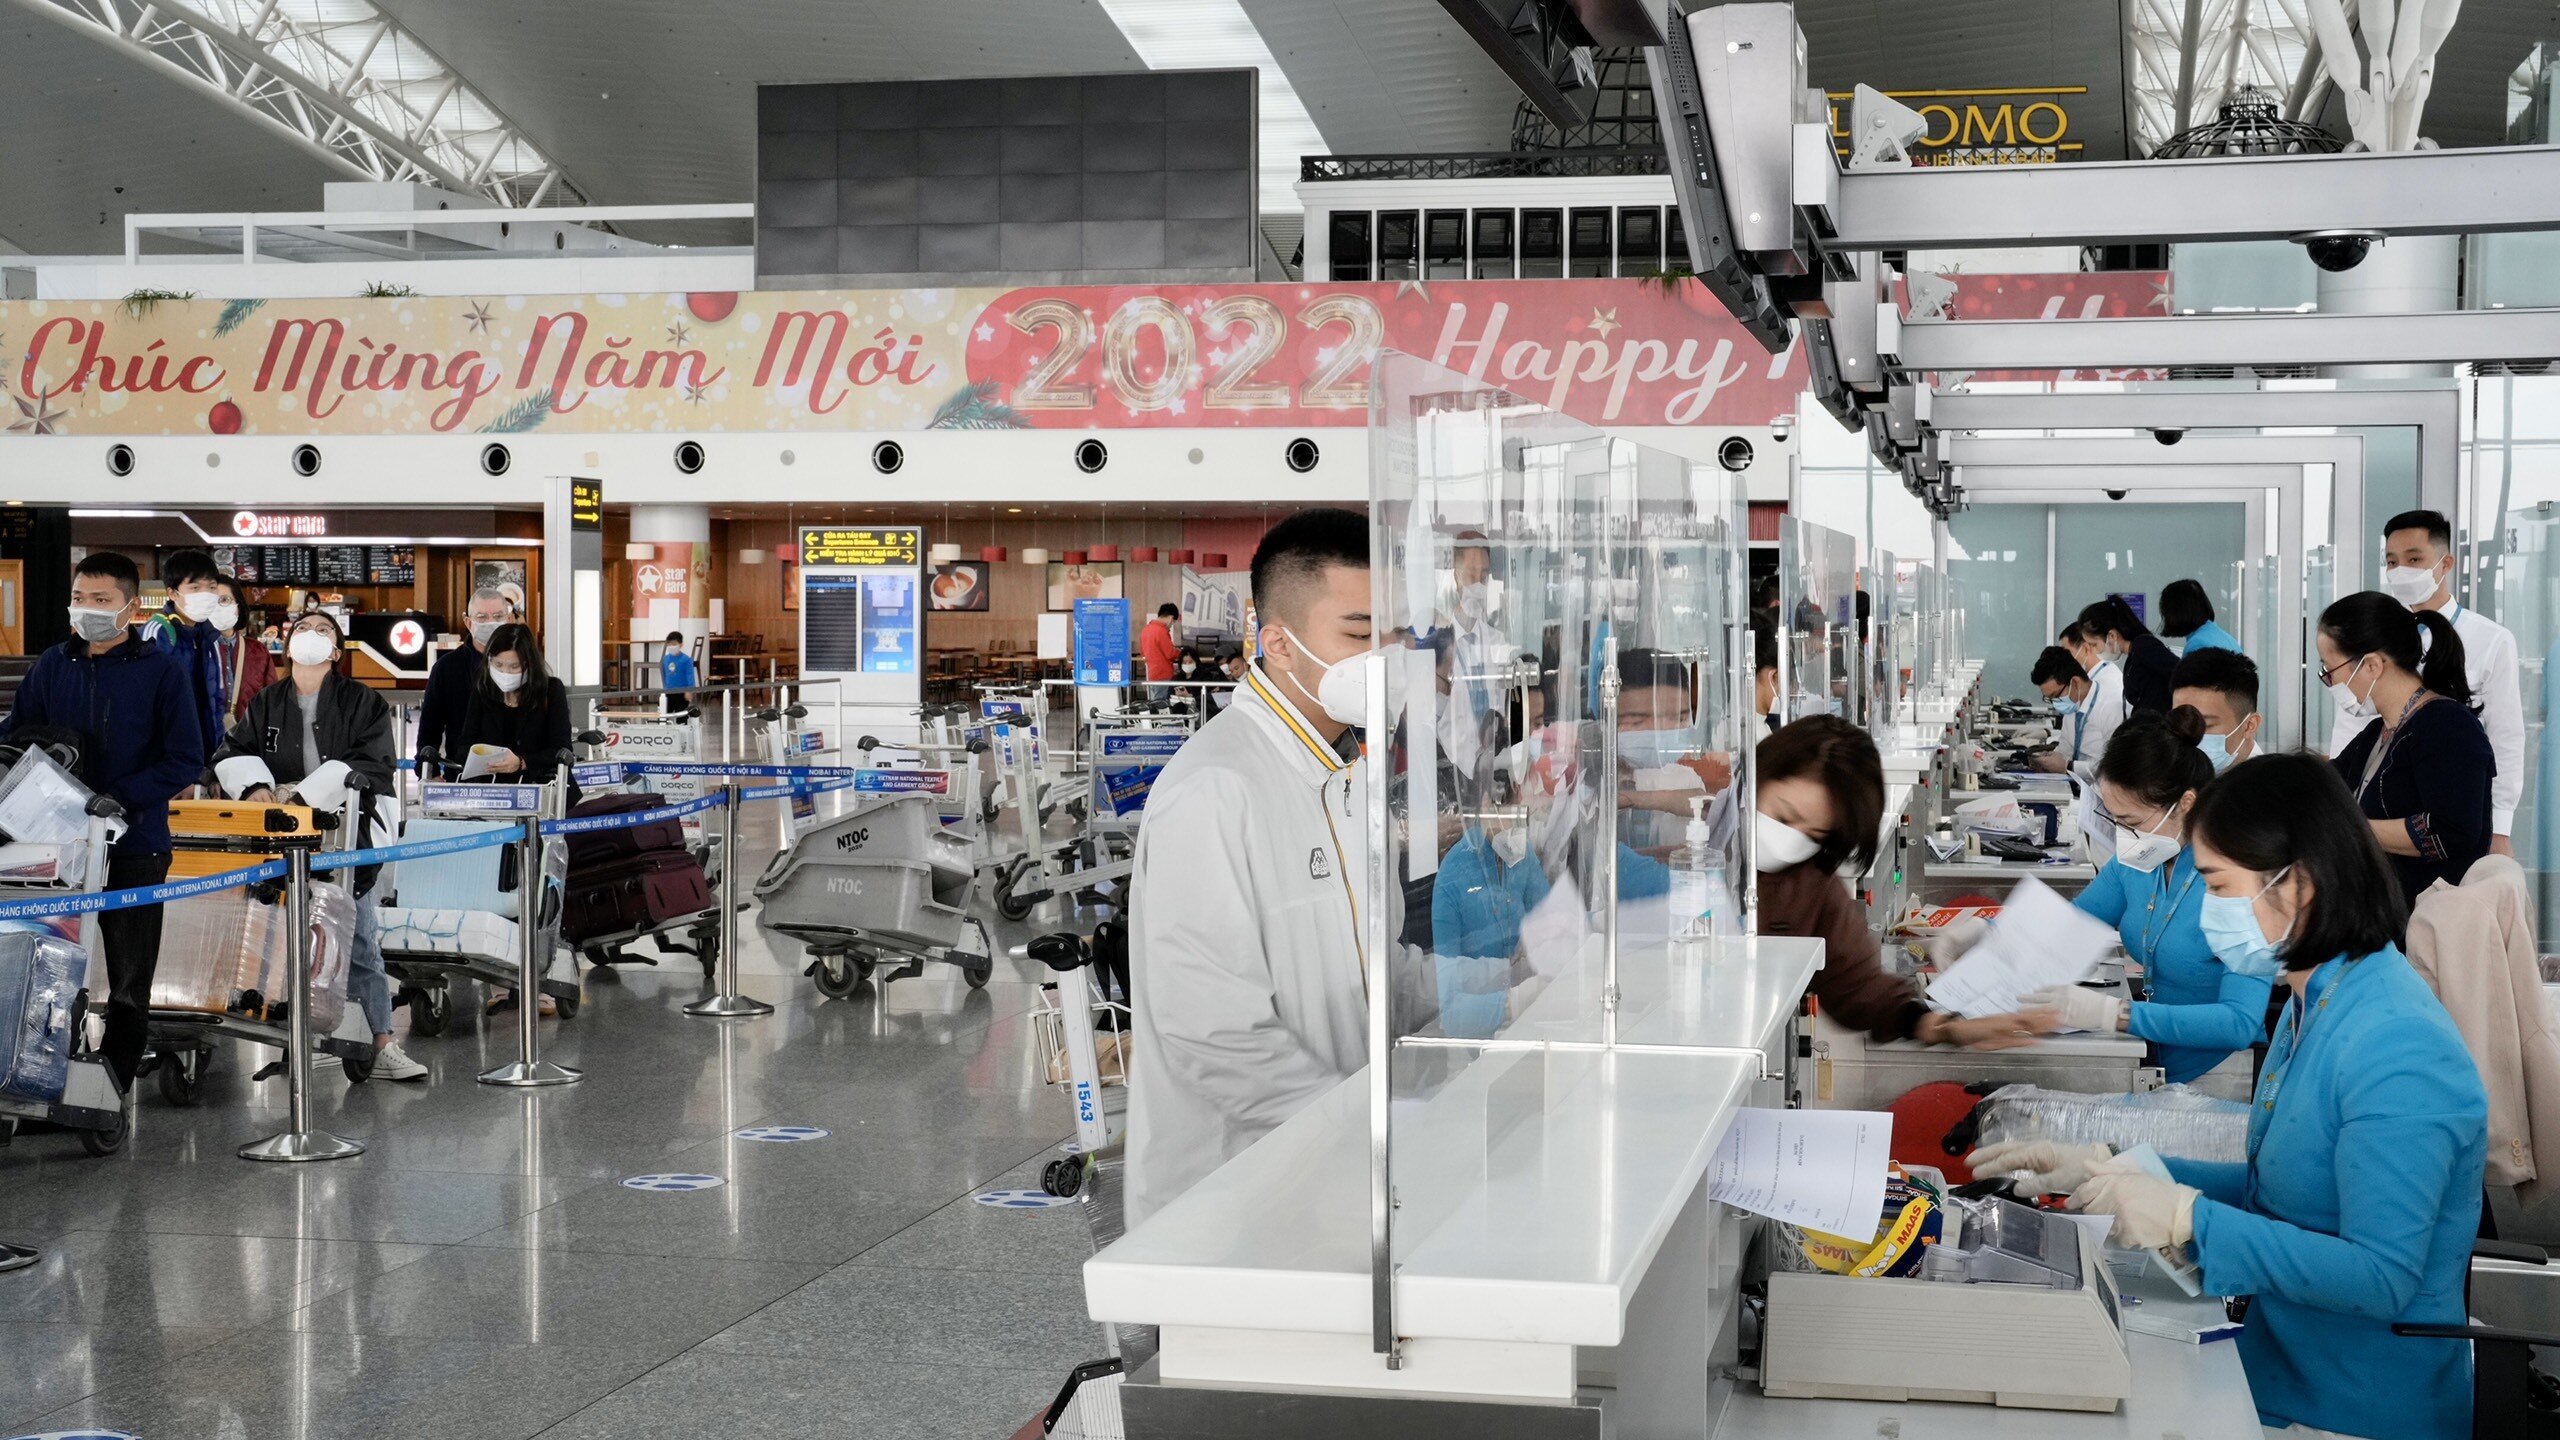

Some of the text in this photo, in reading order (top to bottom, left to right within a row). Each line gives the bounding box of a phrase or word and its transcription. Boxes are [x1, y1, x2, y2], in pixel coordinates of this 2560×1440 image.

[1917, 102, 2068, 147] OMO
[1925, 153, 1992, 166] URANT
[2015, 152, 2057, 165] BAR
[21, 295, 1747, 432] Chúc Mừng Năm Mới 2022 Happy
[664, 568, 686, 580] star
[664, 581, 687, 594] cafe
[623, 736, 673, 746] DORCO
[661, 782, 694, 790] DORCO
[837, 828, 869, 850] NTOC
[22, 902, 47, 916] KHÔNG
[49, 900, 70, 914] QUỐC
[71, 899, 81, 912] TẾ
[153, 886, 174, 899] NOIBAI
[175, 877, 222, 896] INTERNATIONAL
[223, 872, 248, 887] AIRPORT
[827, 877, 862, 895] NTOC
[1077, 1081, 1093, 1121] 1543
[1897, 1204, 1921, 1246] MAAS
